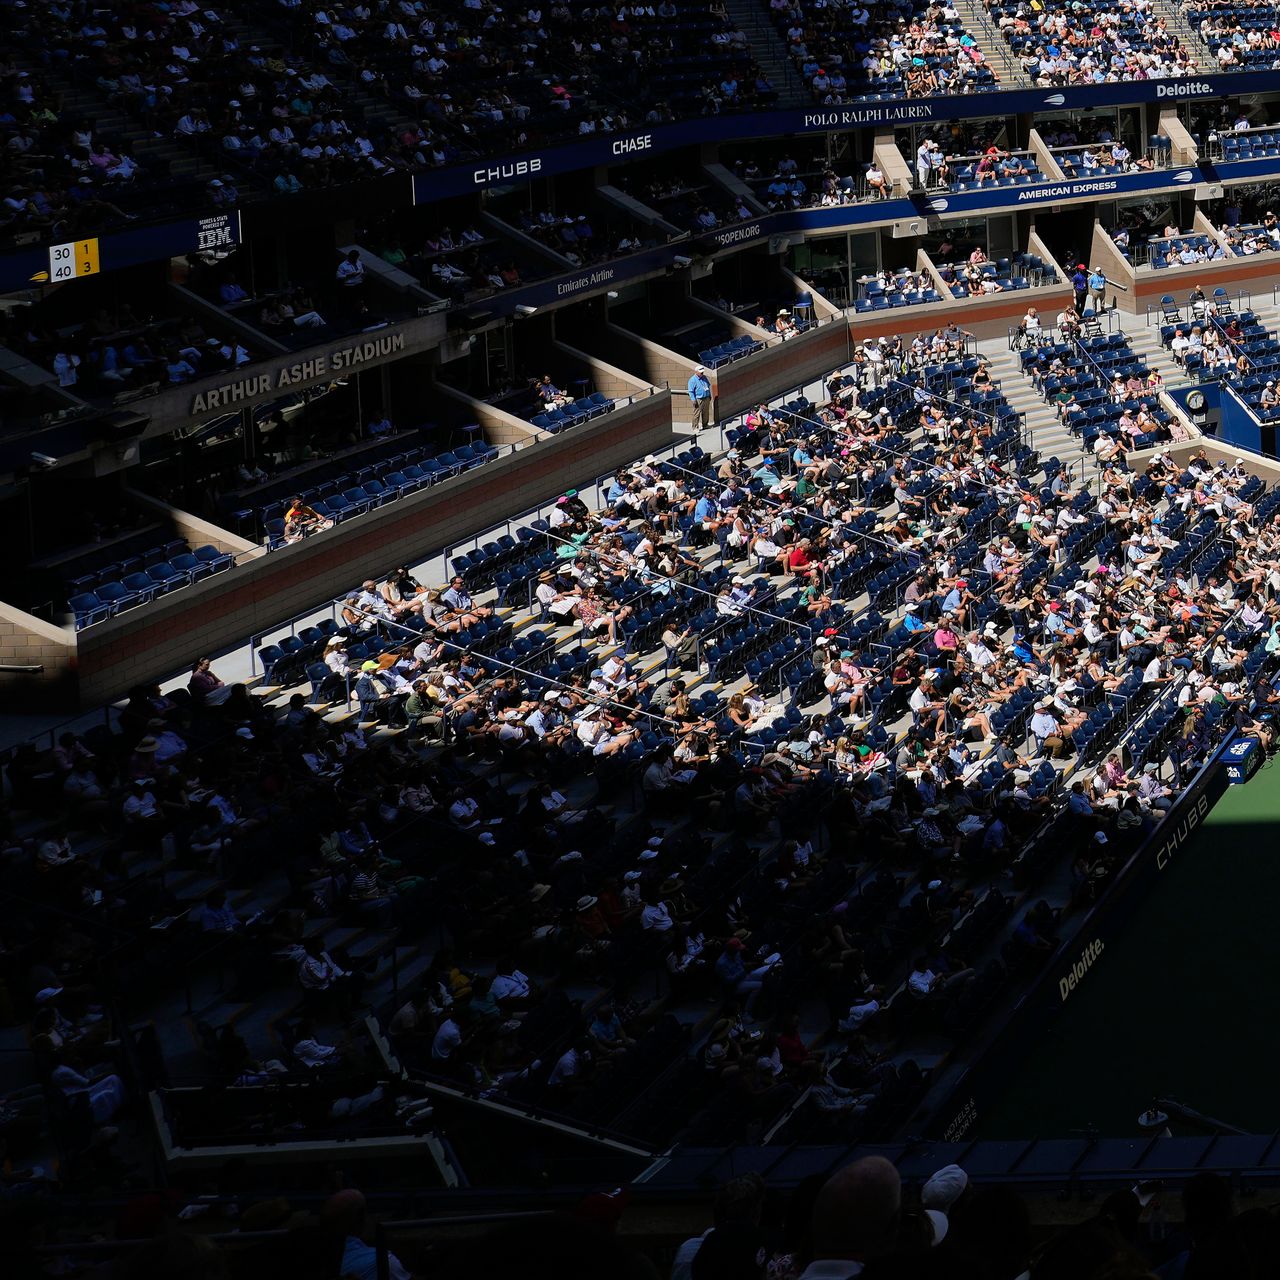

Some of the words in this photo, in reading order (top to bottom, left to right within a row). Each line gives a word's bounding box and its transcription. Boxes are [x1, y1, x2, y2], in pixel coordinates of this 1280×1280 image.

[1156, 82, 1214, 99] Deloitte.
[804, 111, 840, 127] POLO
[841, 108, 882, 125] RALPH
[885, 104, 933, 121] LAUREN
[611, 134, 653, 156] CHASE
[473, 158, 543, 184] CHUBB
[1017, 185, 1071, 202] AMERICAN
[1072, 180, 1117, 194] EXPRESS
[197, 226, 234, 250] IBM
[54, 247, 71, 261] 30
[55, 265, 72, 279] 40
[84, 261, 92, 273] 3
[557, 276, 589, 296] Emirates
[590, 267, 615, 284] Airline
[191, 373, 273, 416] ARTHUR
[277, 356, 327, 389] ASHE
[330, 332, 405, 371] STADIUM
[1156, 793, 1209, 871] CHUBB
[1057, 936, 1106, 1002] Deloitte.
